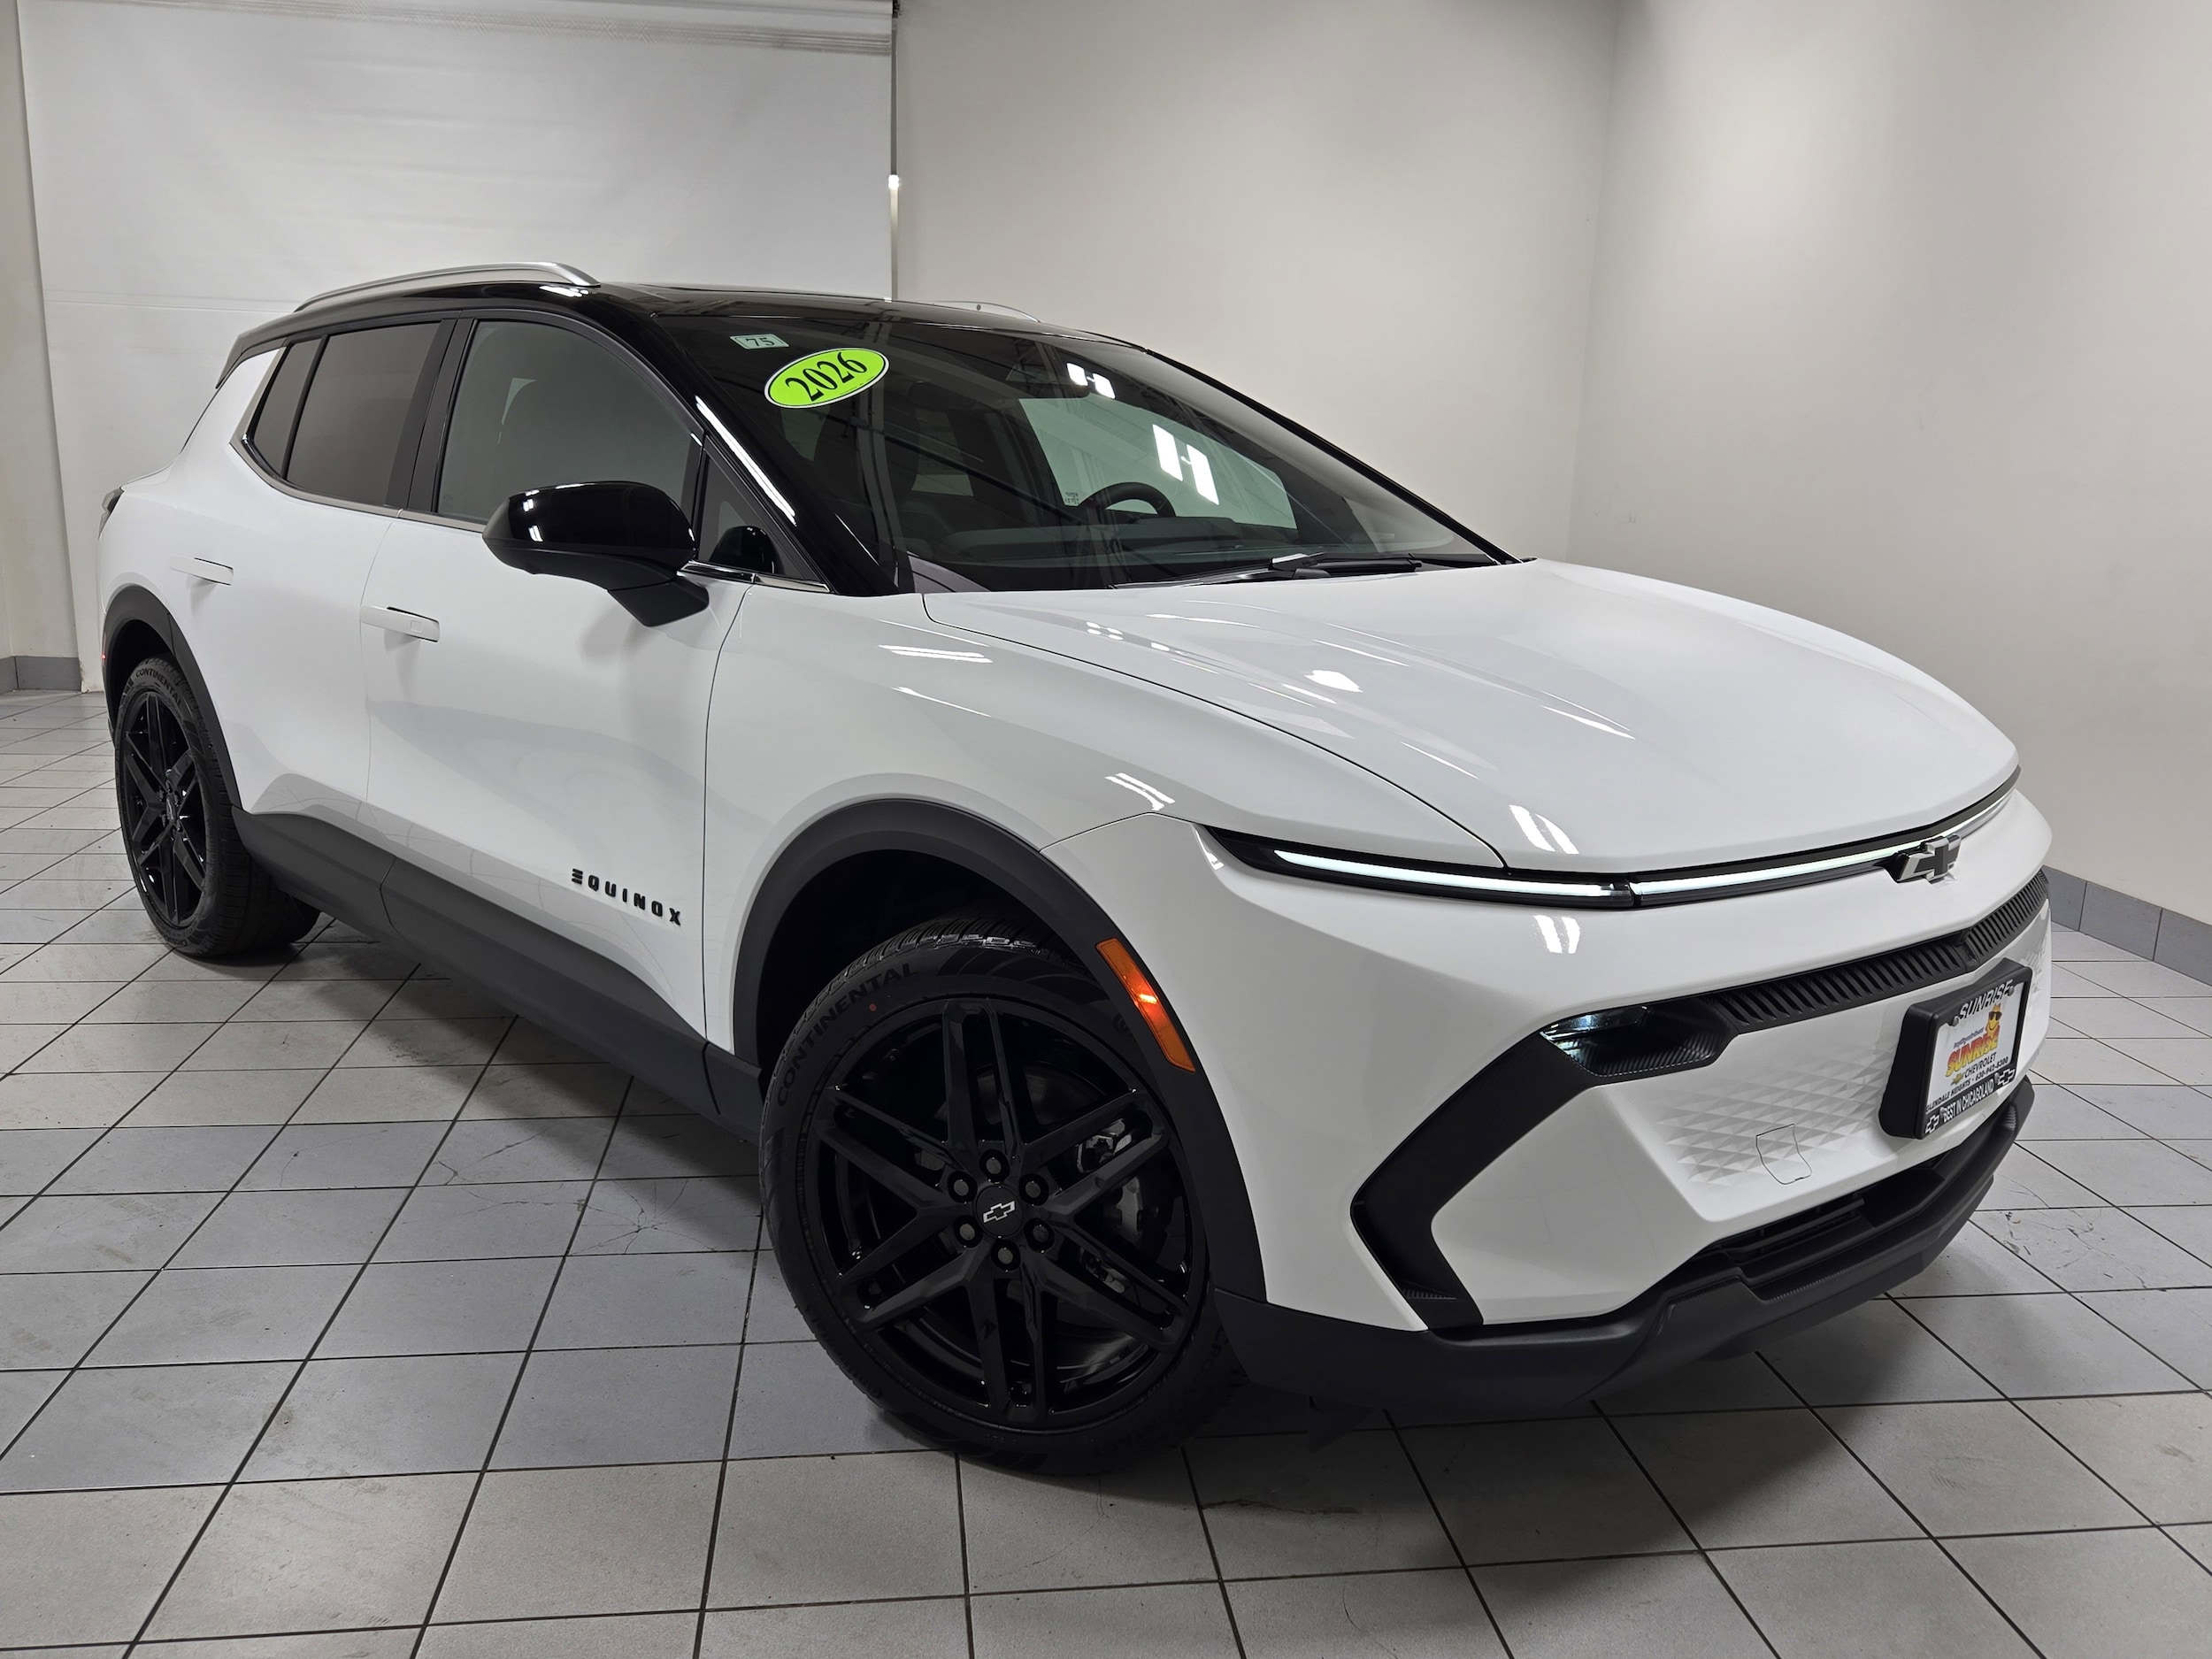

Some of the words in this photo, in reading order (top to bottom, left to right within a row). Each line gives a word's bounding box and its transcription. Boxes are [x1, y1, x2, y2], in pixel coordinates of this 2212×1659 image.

[746, 337, 776, 347] 75
[785, 351, 868, 402] 2026
[572, 868, 681, 926] EQUINOX
[1958, 979, 2014, 1019] SUNRISE
[778, 963, 920, 1106] CONTINENTAL
[1945, 1032, 2001, 1078] SUNRISE
[1964, 1051, 1997, 1079] CHEVROLET
